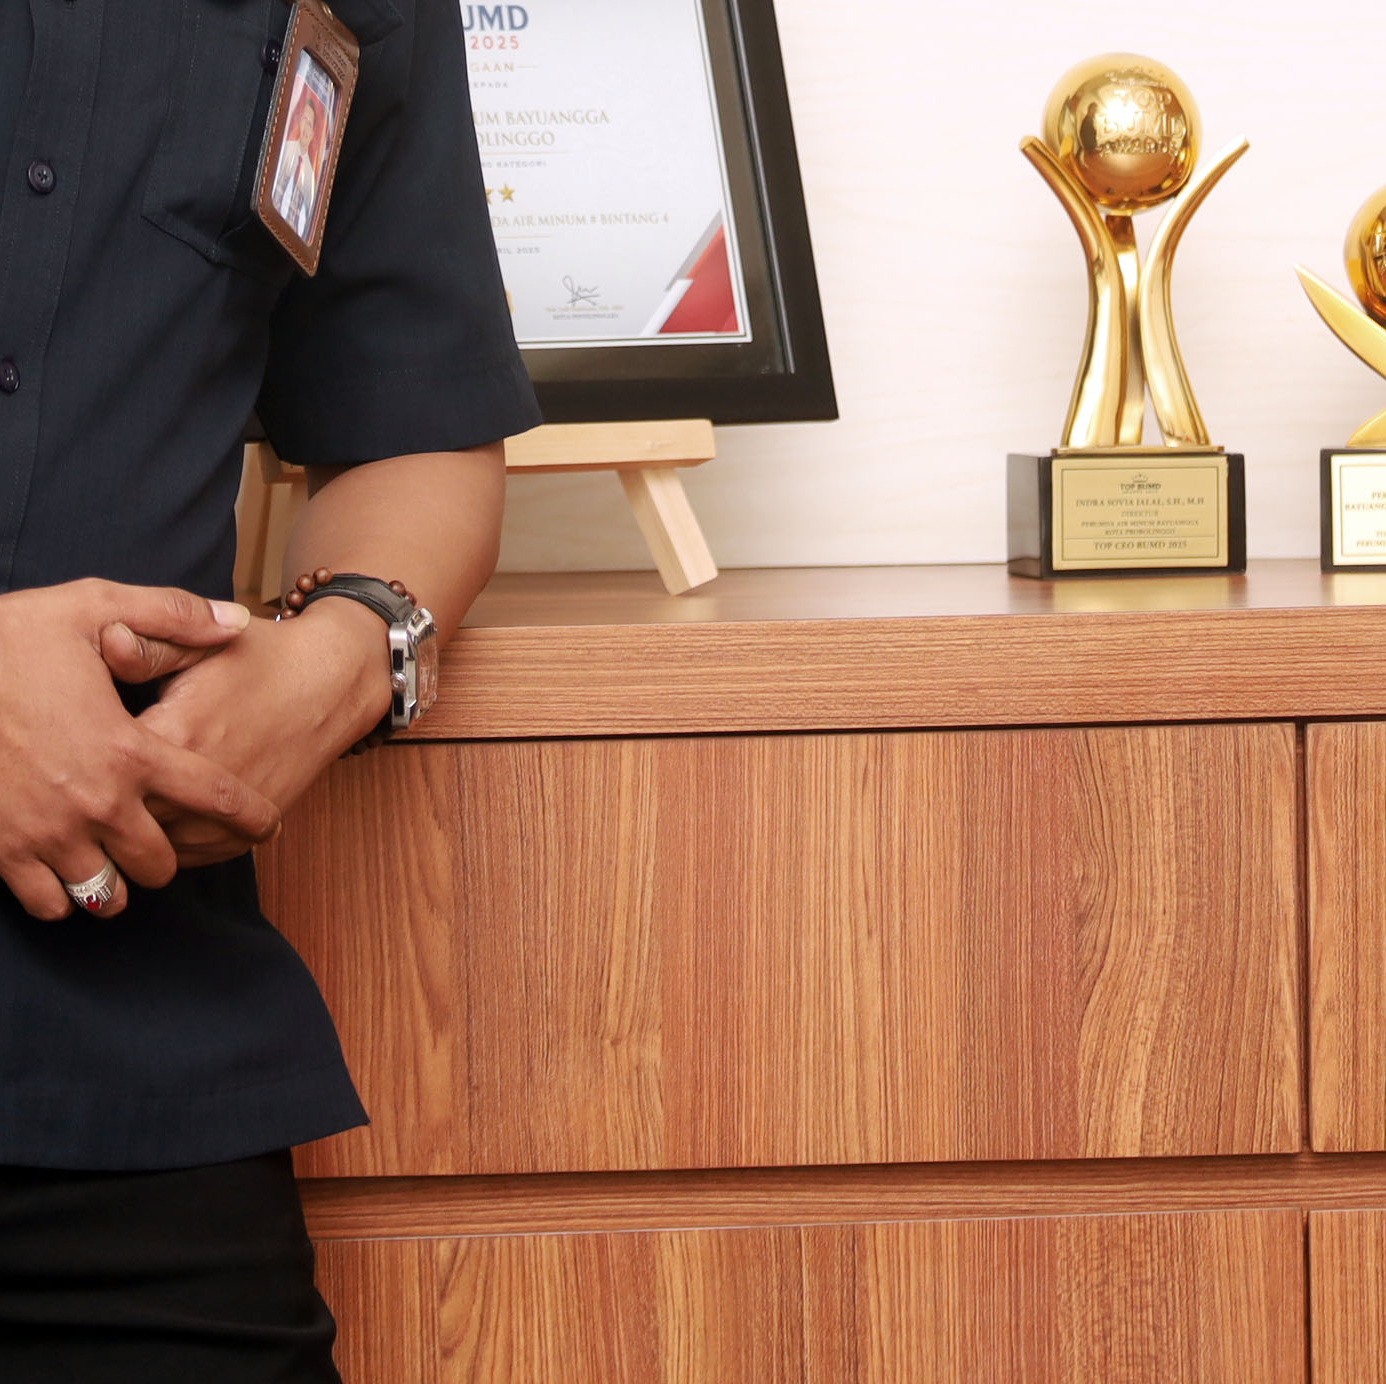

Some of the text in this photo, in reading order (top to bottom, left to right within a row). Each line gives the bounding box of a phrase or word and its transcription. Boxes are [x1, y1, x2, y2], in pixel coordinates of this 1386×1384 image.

[463, 5, 528, 31] UMD
[471, 36, 519, 49] 2025
[506, 110, 609, 125] BAYUANGGA
[513, 216, 536, 227] AIR
[539, 215, 586, 226] MINUM
[601, 213, 659, 225] BINTANG
[1094, 542, 1112, 551] TOP
